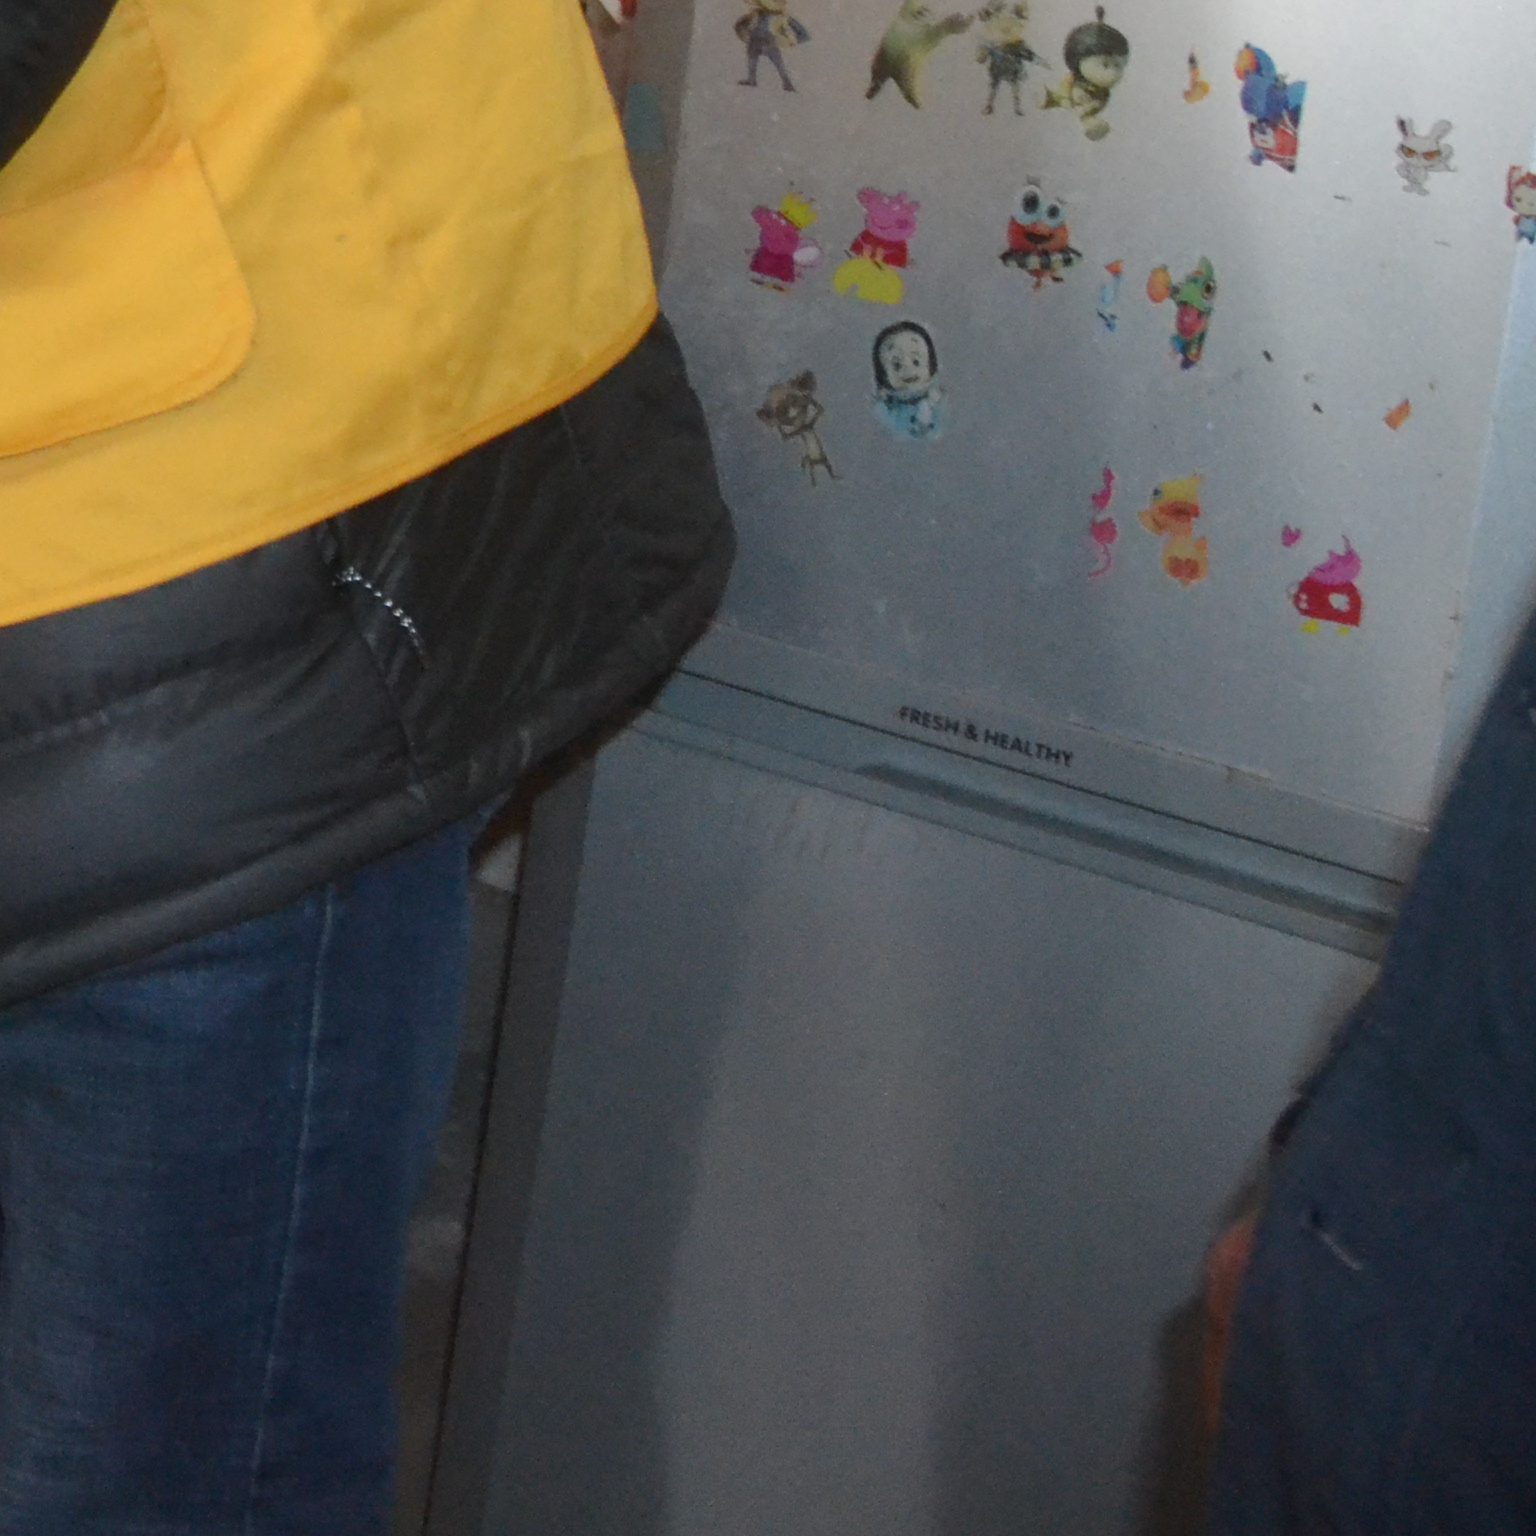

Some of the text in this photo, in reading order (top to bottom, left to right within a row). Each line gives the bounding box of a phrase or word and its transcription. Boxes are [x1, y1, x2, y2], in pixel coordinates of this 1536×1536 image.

[898, 705, 1074, 768] FRESH & HEALTHY
